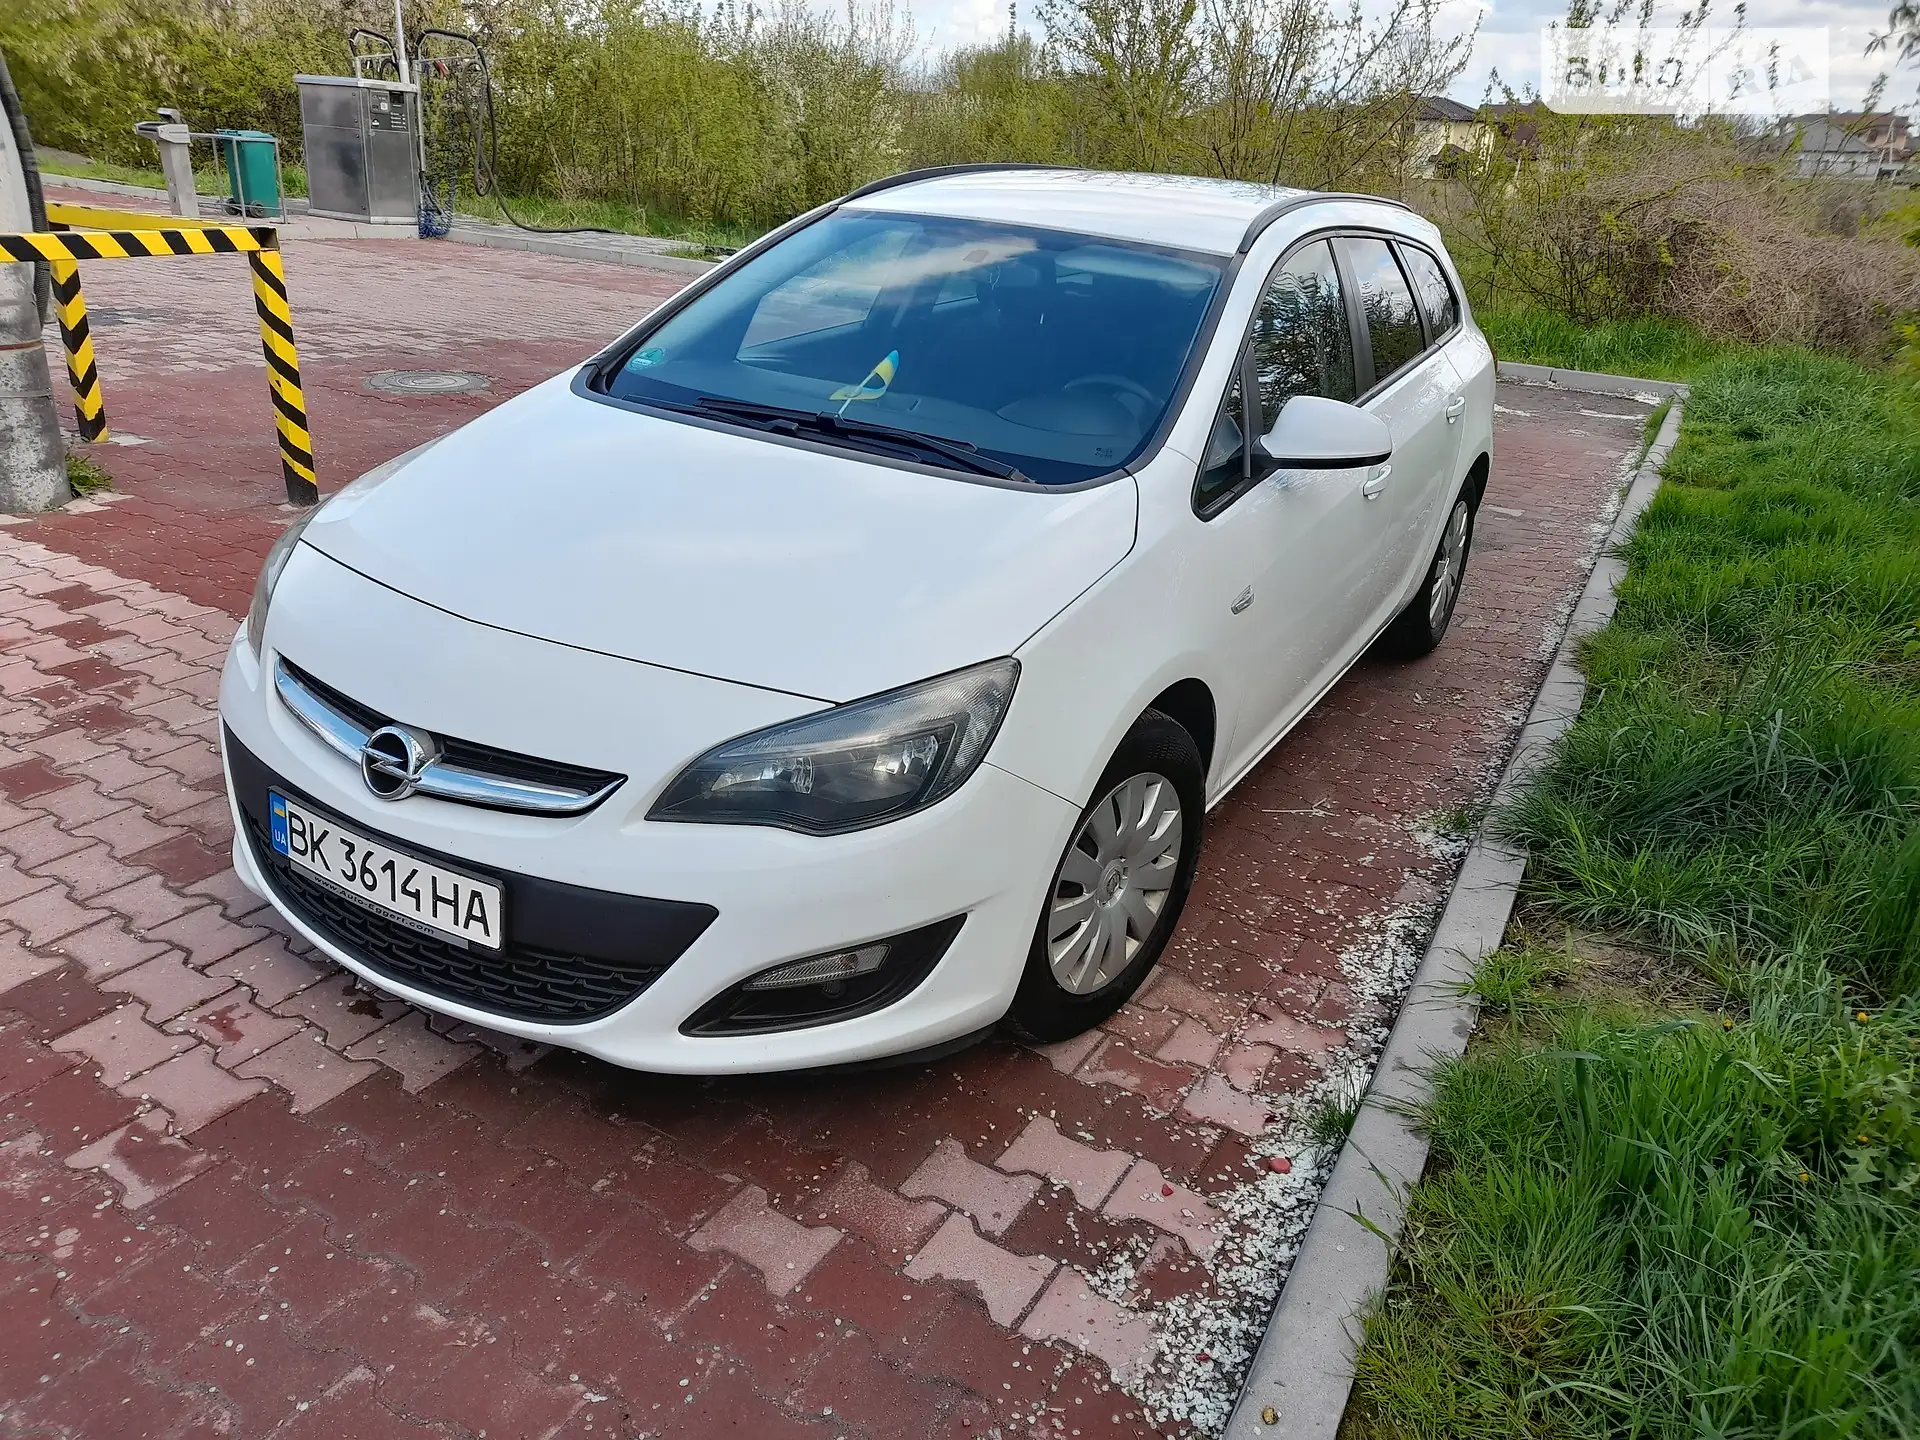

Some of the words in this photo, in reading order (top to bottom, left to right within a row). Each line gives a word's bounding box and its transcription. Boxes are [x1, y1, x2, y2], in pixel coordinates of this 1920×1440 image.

[274, 829, 287, 848] UA
[288, 811, 332, 872] BK
[338, 838, 422, 913] 3614
[431, 874, 491, 938] HA
[313, 875, 435, 936] www.Auto-Eggert.com
